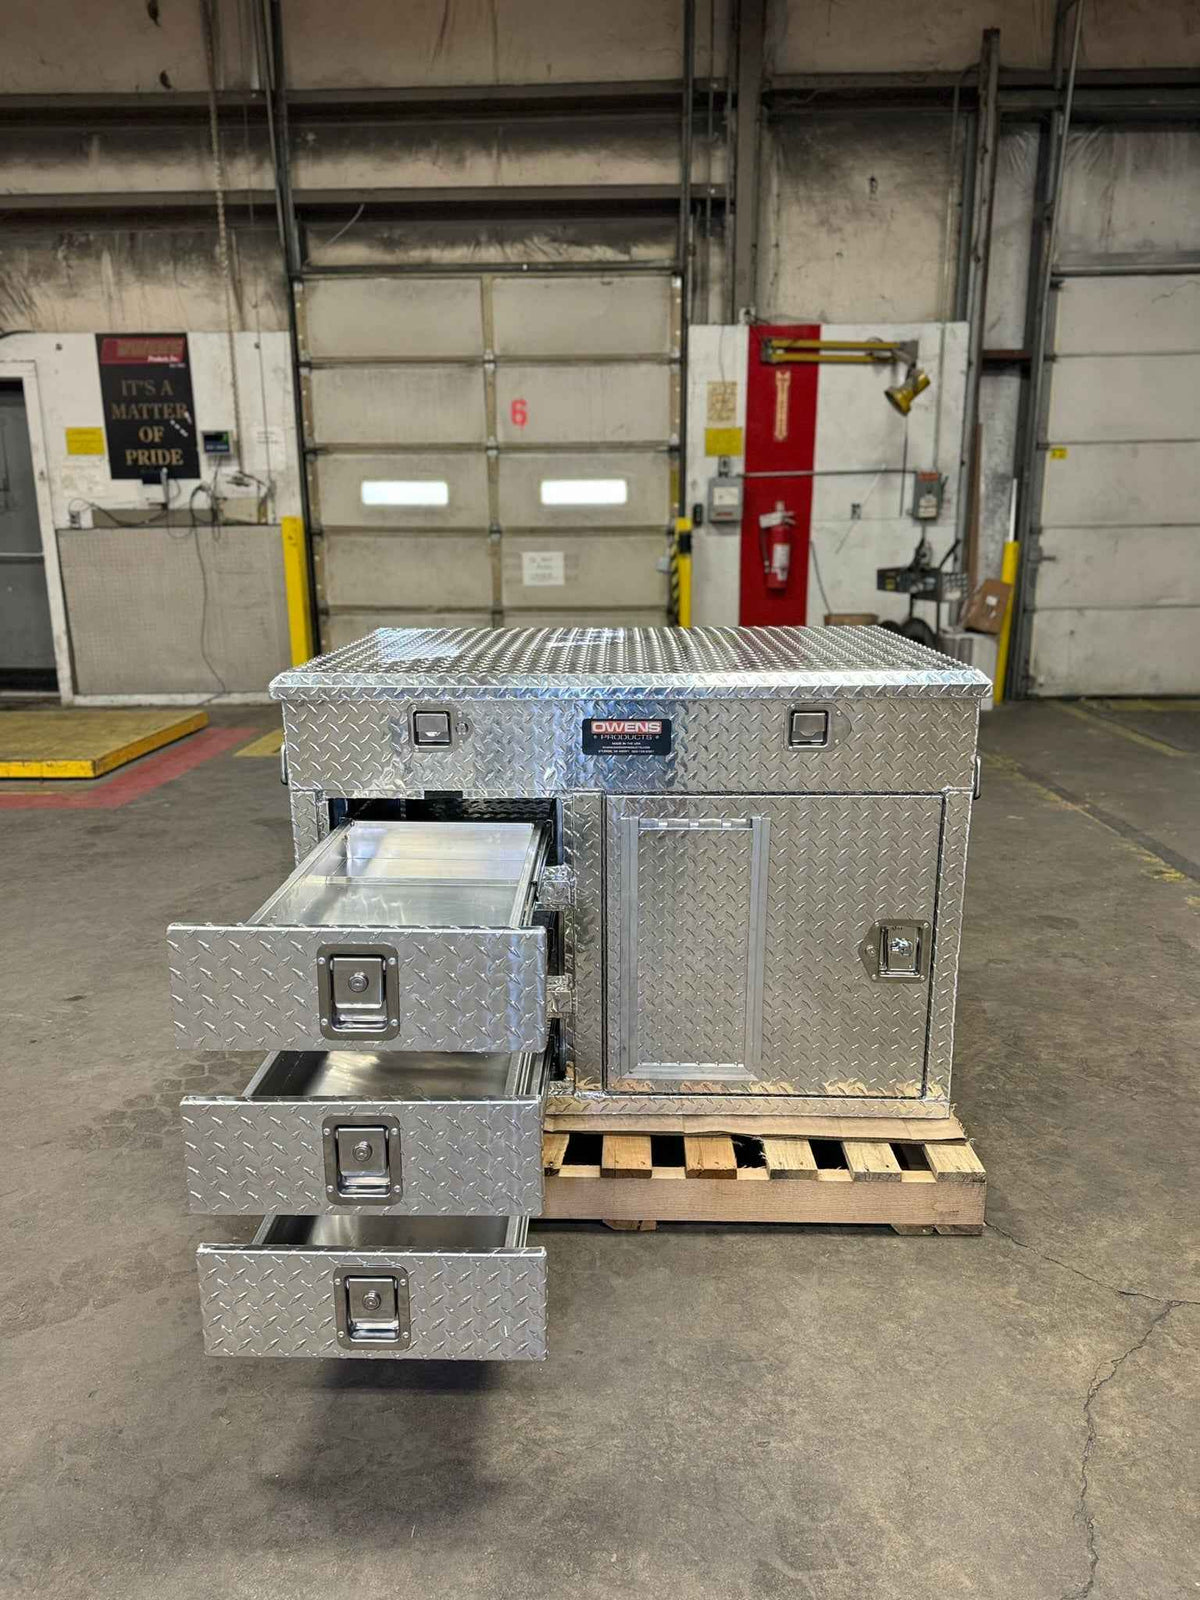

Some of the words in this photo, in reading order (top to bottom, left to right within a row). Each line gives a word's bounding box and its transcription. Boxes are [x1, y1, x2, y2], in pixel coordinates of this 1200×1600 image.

[121, 380, 156, 396] IT'S
[161, 380, 174, 396] A
[112, 402, 187, 420] MATTER
[511, 399, 528, 427] 6
[138, 426, 164, 443] OF
[125, 448, 184, 466] PRIDE
[592, 722, 660, 733] OWENS
